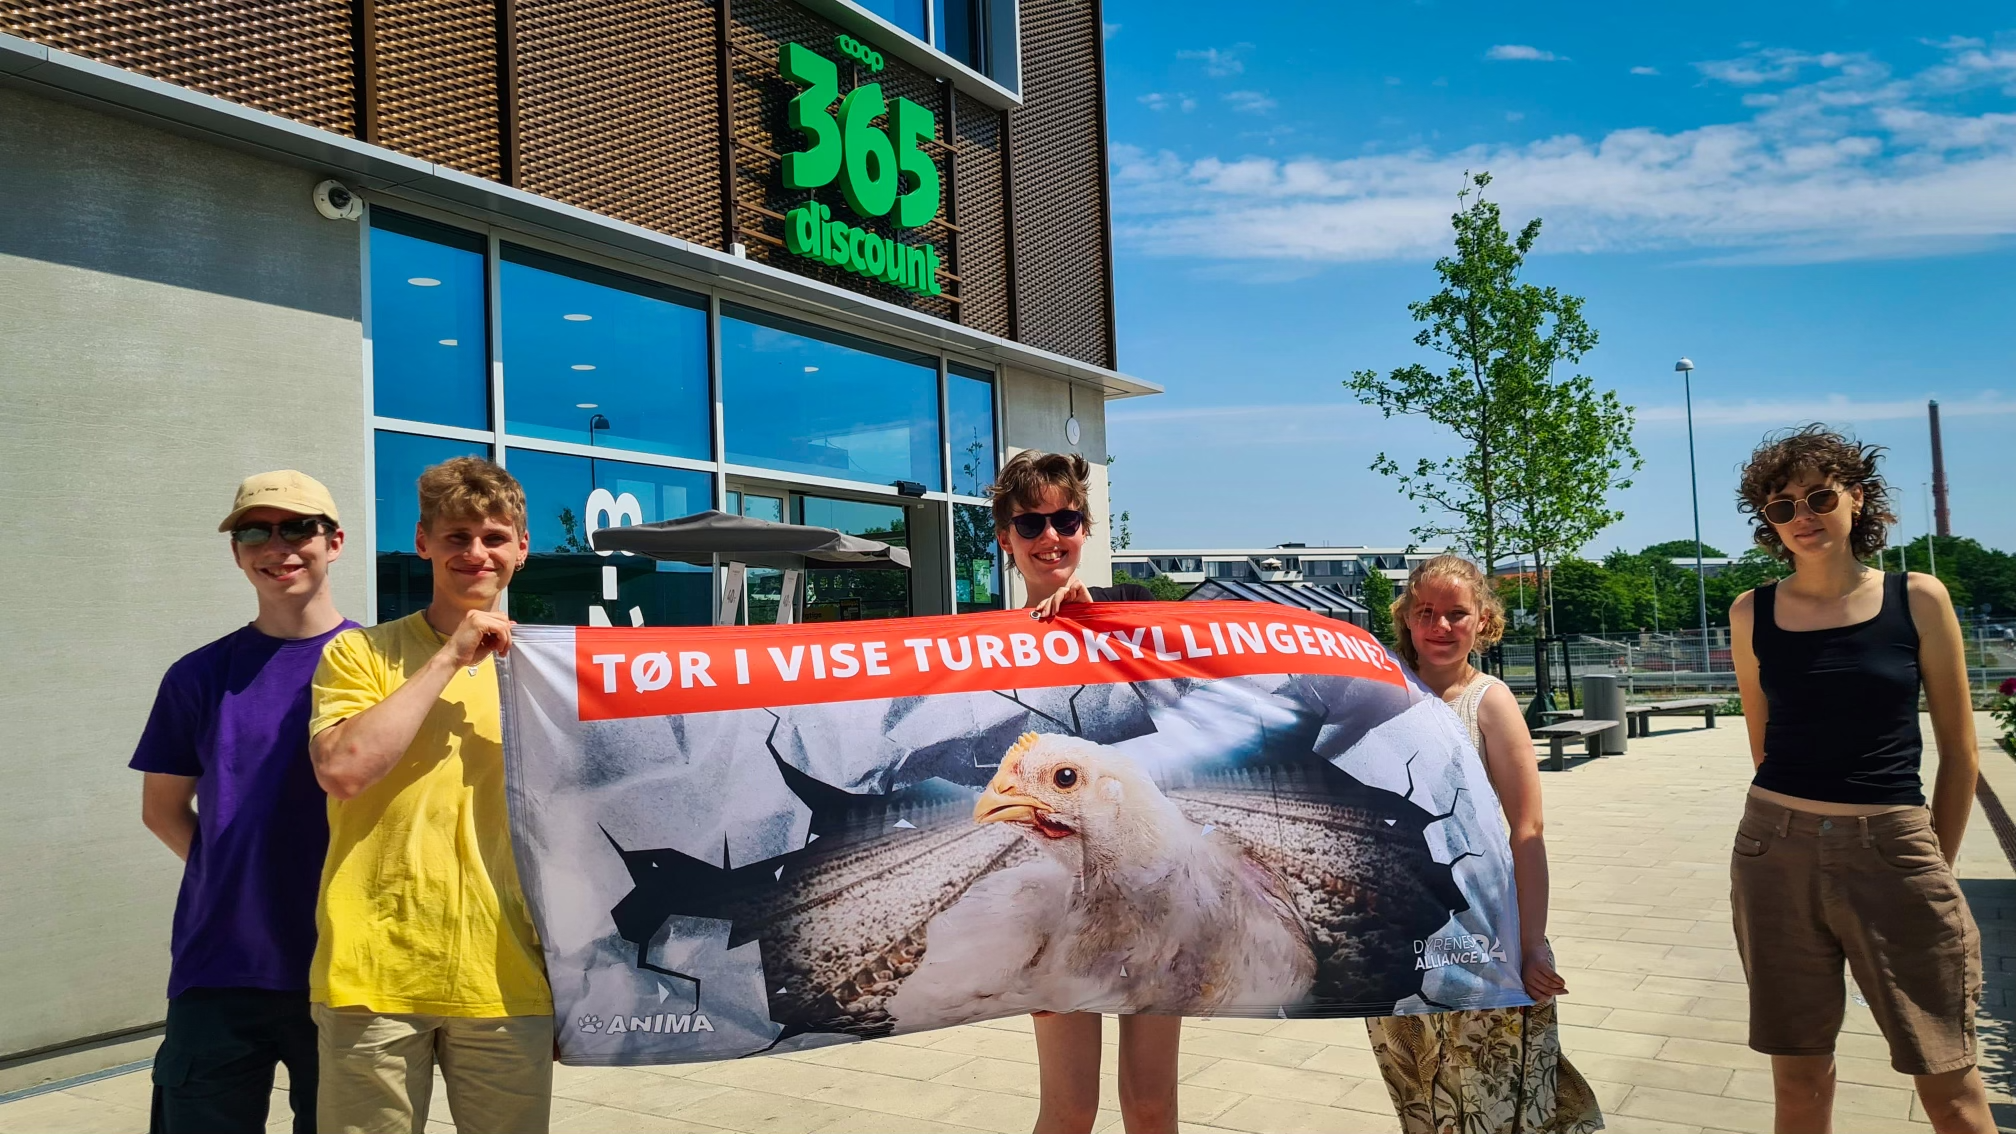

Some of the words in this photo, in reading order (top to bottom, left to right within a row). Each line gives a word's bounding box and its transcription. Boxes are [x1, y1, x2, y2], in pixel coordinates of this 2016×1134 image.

[834, 34, 884, 73] coop
[779, 42, 940, 228] 365
[785, 200, 941, 297] discount
[592, 651, 717, 694] TØR
[734, 648, 750, 685] I
[767, 641, 891, 682] VISE
[1413, 935, 1476, 954] DYRENES
[1414, 951, 1478, 970] ALLIANCE
[606, 1013, 715, 1034] ANIMA
